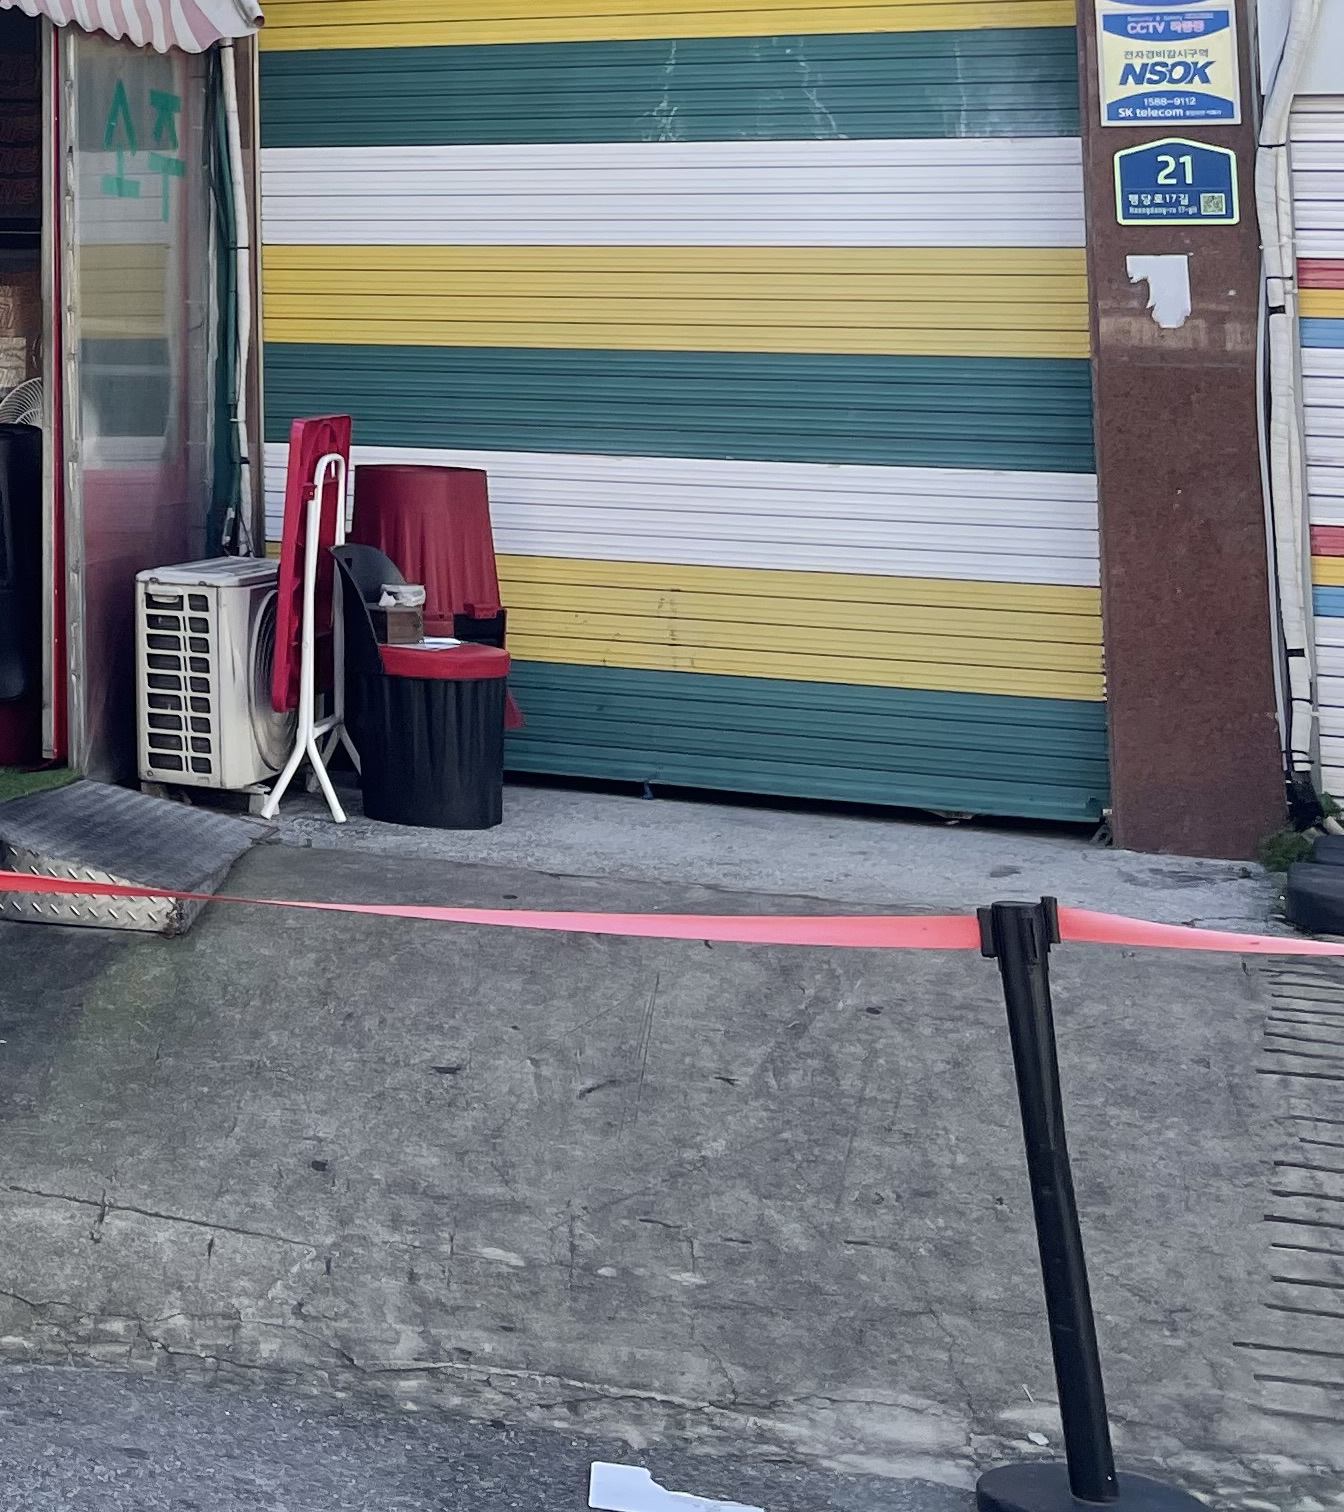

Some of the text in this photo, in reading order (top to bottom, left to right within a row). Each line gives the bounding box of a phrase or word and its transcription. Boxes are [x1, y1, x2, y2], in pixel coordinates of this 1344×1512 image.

[1127, 21, 1165, 34] CCTV
[1119, 60, 1217, 86] NSOK
[1144, 97, 1196, 106] 1588-9112
[1118, 108, 1133, 118] SK
[1136, 108, 1183, 117] telecom
[1157, 155, 1192, 184] 21
